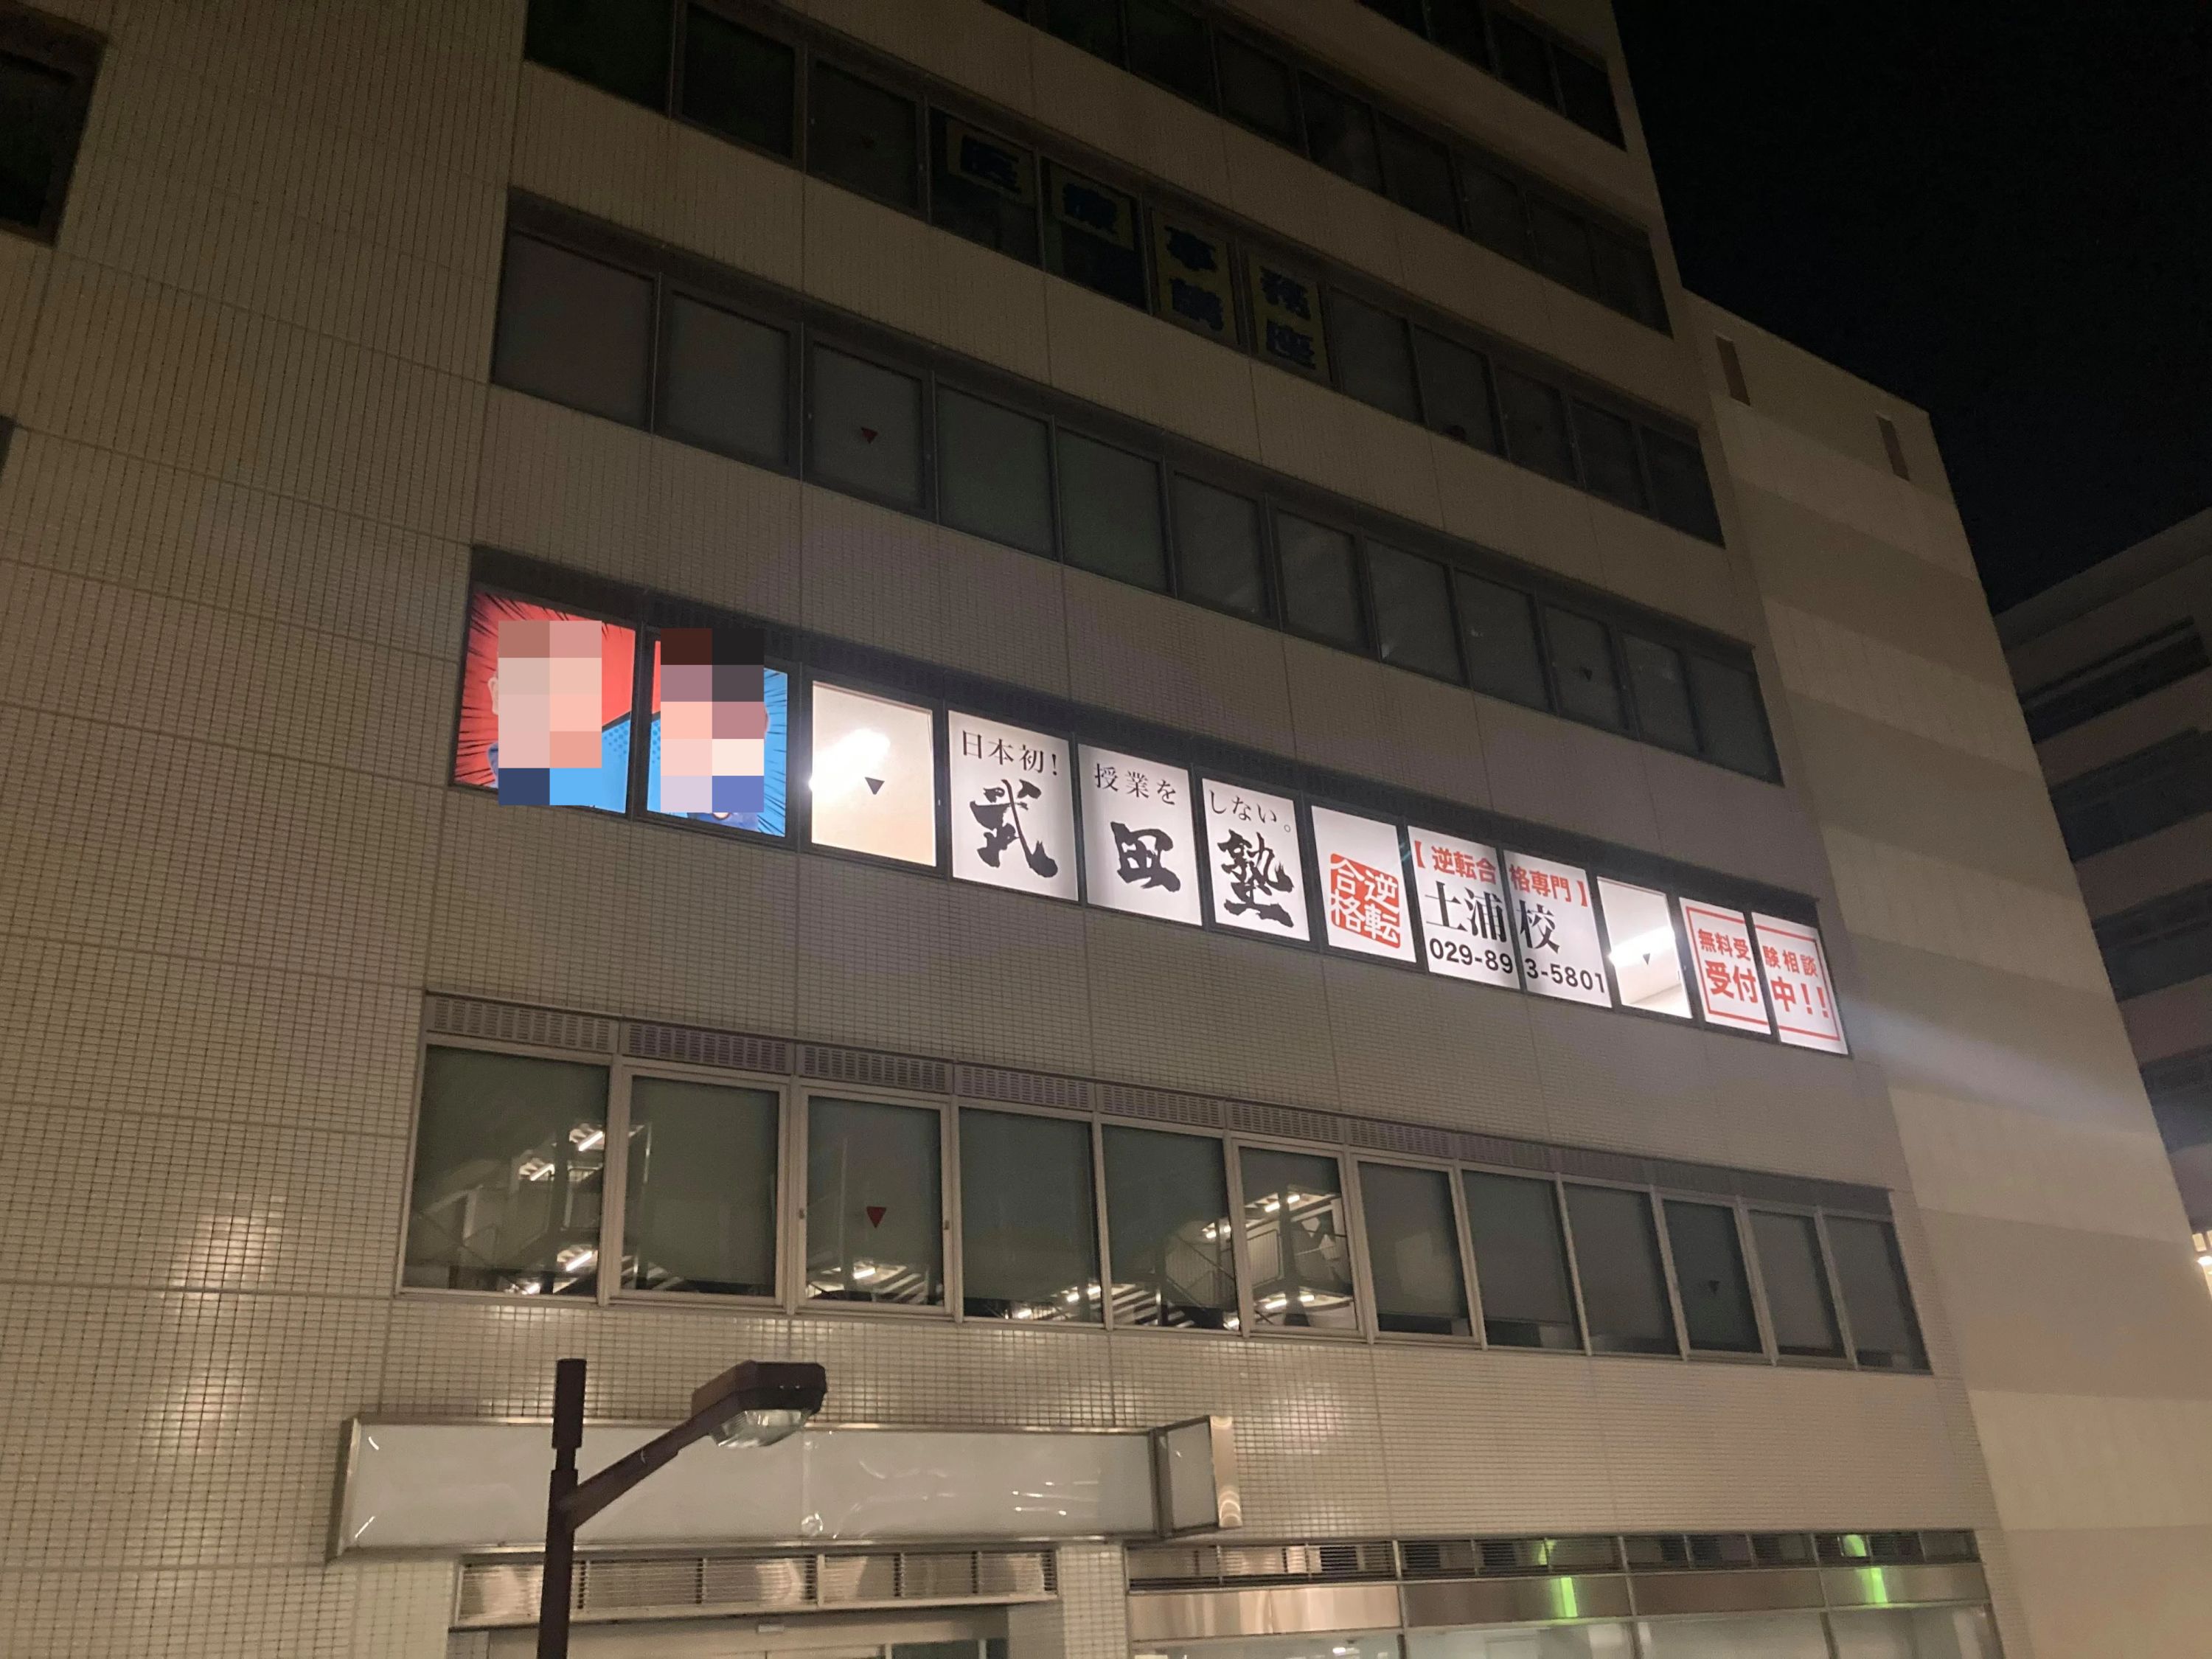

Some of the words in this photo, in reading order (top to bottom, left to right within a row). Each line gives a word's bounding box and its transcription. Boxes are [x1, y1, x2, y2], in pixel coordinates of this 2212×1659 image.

[1094, 762, 1177, 806] 授業を
[969, 779, 1294, 928] 武田塾
[1425, 880, 1561, 955] 土浦校
[1429, 937, 1606, 995] 029-893-5801
[1697, 928, 1819, 978] 無料受験相談
